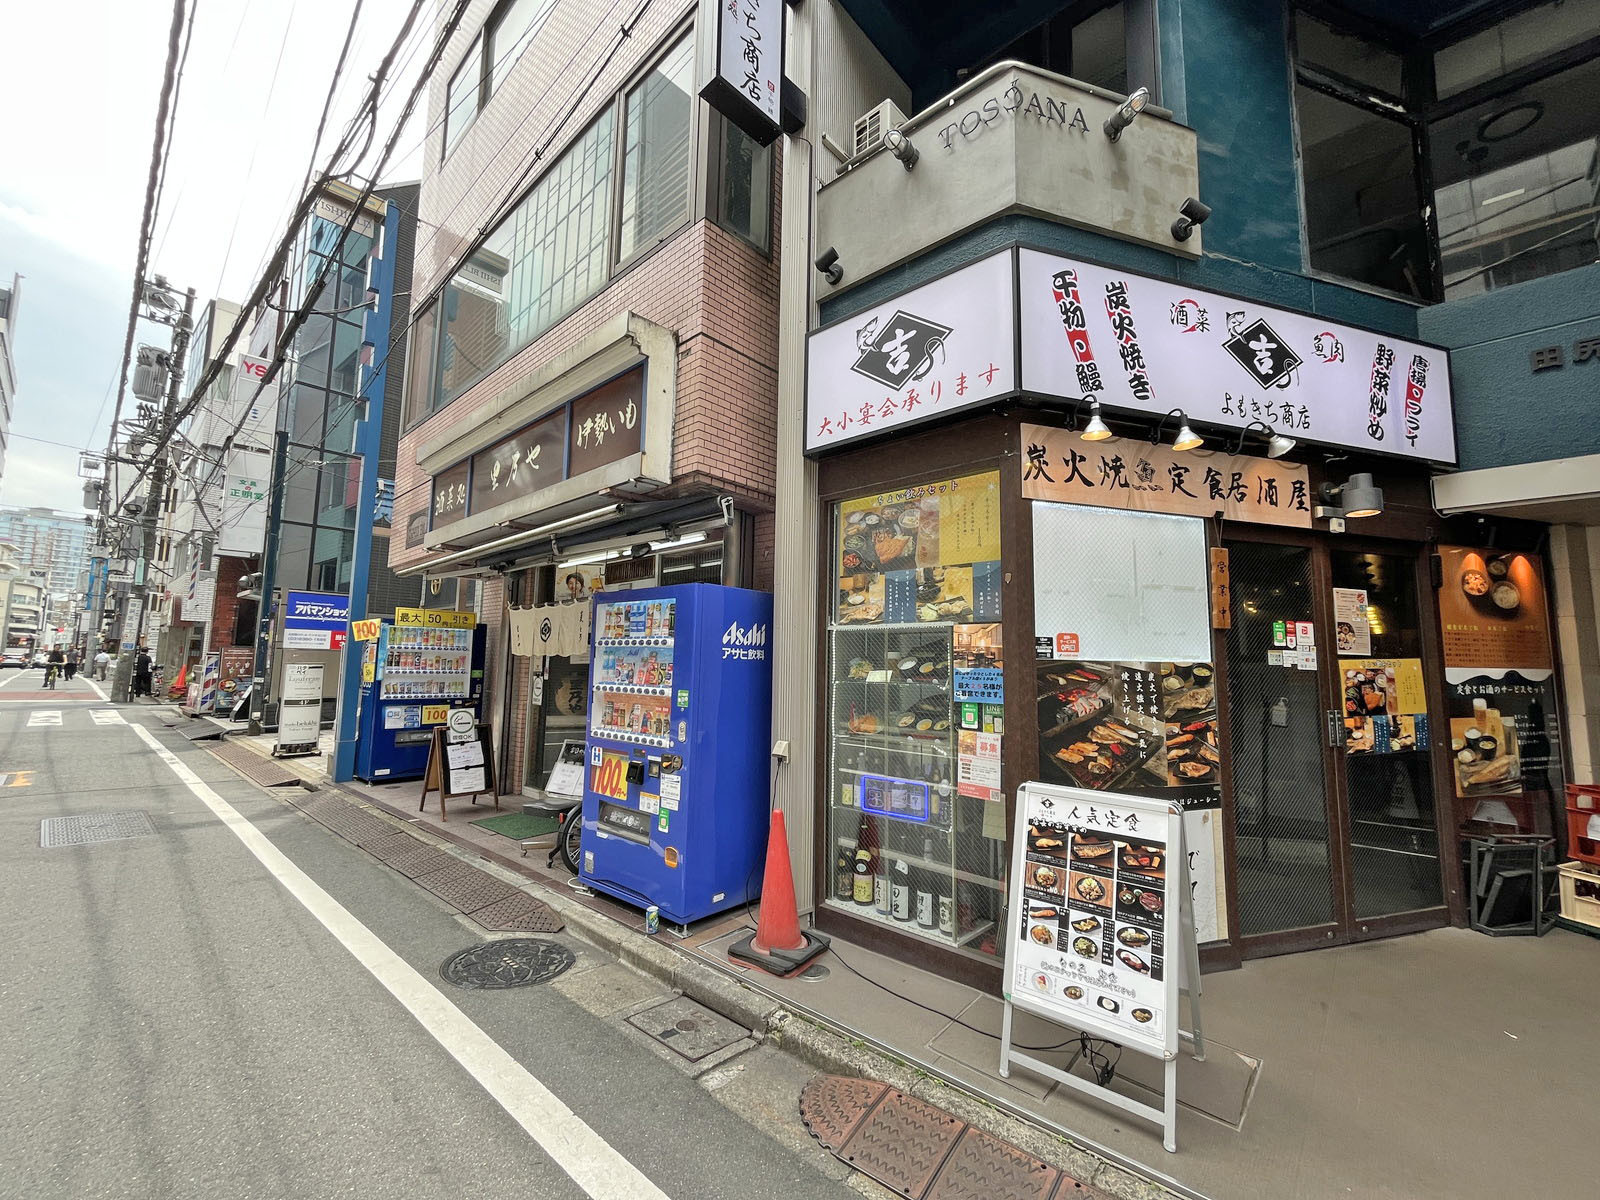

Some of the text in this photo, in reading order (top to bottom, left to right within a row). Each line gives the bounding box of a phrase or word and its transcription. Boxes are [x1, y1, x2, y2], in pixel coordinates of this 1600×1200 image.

[1105, 281, 1150, 400] 炭火焼き
[817, 363, 1000, 436] 大小宴会承ります
[1368, 344, 1394, 441] 野菜炒め
[1222, 393, 1311, 430] よもきち商店
[877, 481, 958, 505] ちょい飲みセット
[722, 621, 766, 647] Asahi
[722, 647, 764, 661] アサヒ飲料
[1068, 805, 1141, 833] 人気定食
